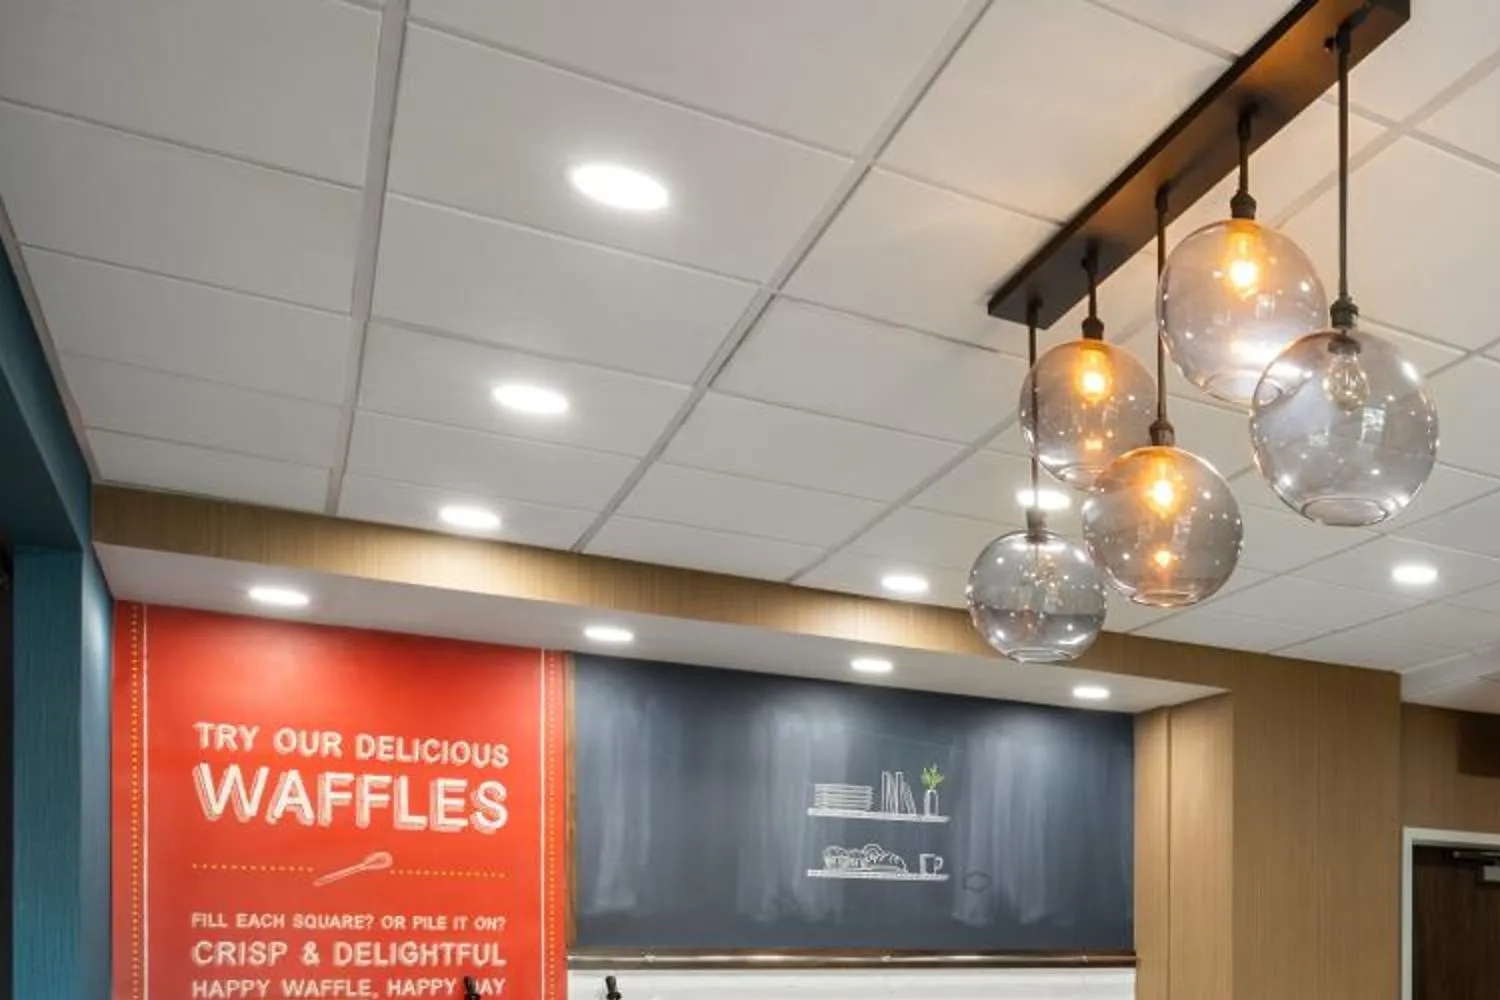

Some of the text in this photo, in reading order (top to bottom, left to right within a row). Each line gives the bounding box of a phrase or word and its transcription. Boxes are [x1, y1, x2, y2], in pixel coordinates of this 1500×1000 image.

[192, 721, 509, 768] TRY OUR DELICIOUS
[192, 762, 509, 834] WAFFLES
[191, 911, 507, 932] FILL EACH SQUARE? OR PILE IT ON?
[191, 940, 508, 968] CRISP & DELIGHTFUL
[191, 978, 270, 999] HAPPY
[281, 978, 379, 999] WAFFLE,
[386, 977, 457, 998] HAPPY
